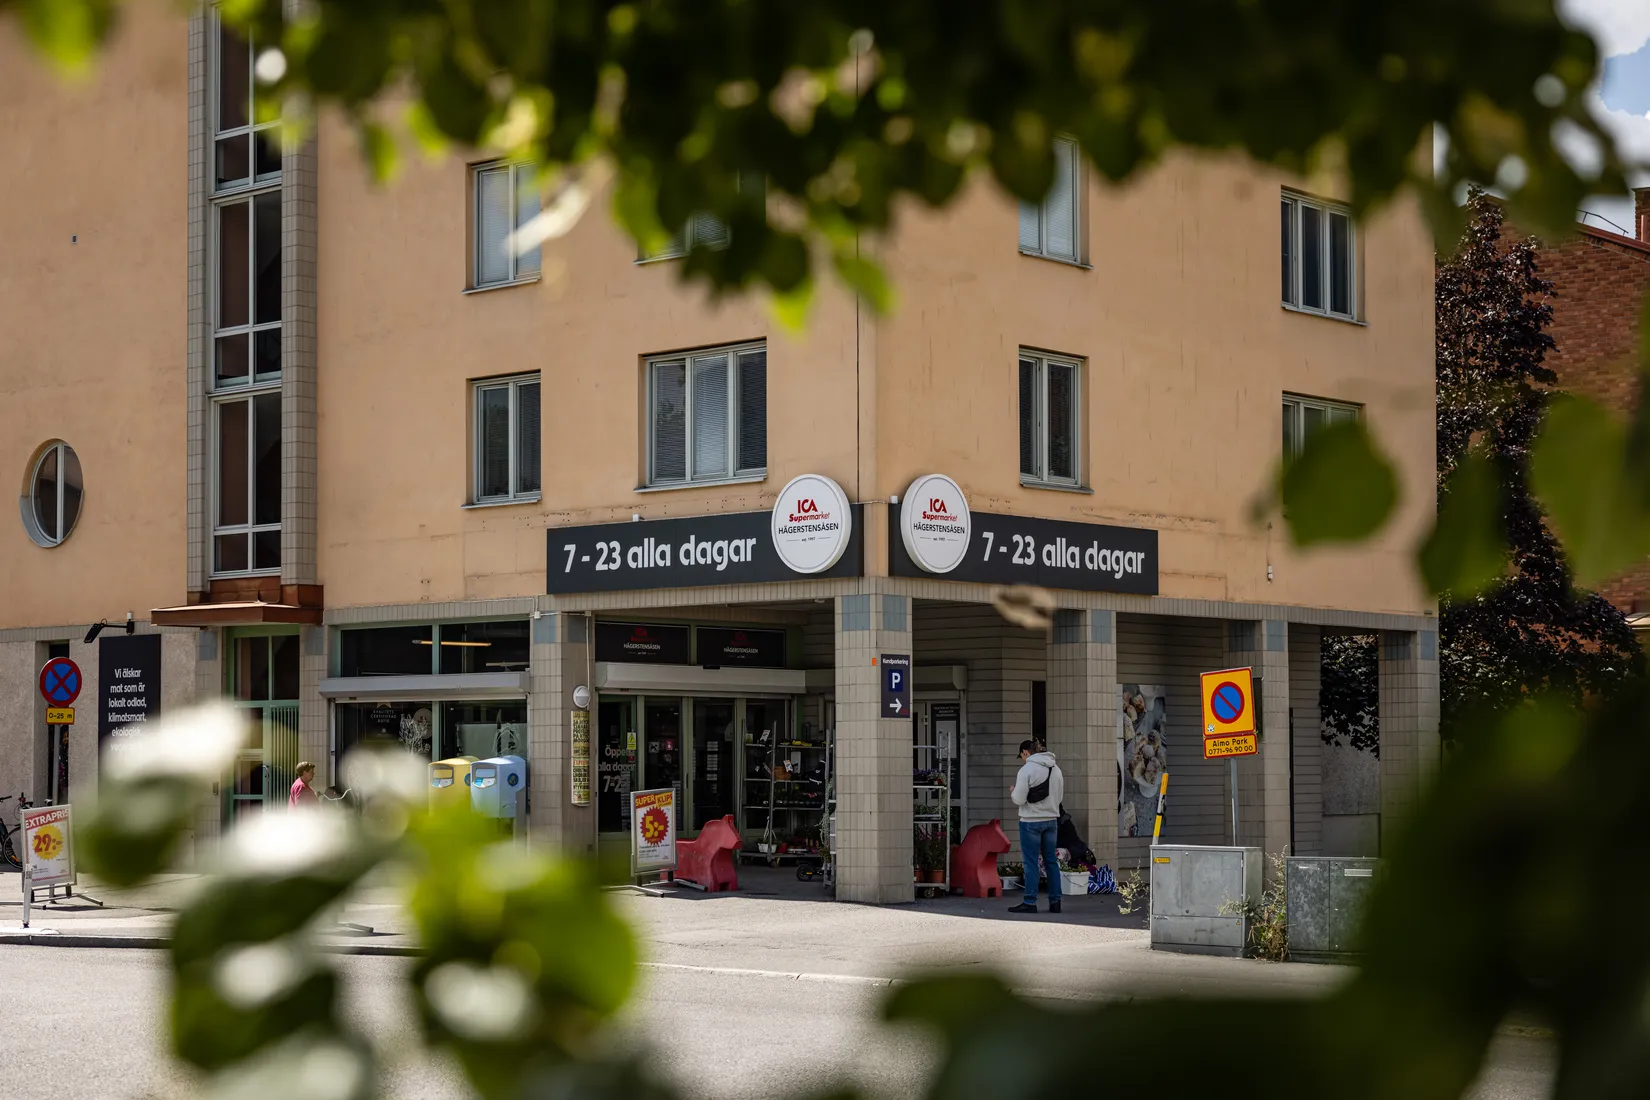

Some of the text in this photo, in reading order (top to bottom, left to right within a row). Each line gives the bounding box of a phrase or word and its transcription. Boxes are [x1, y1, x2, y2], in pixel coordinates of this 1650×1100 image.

[797, 499, 818, 513] ICA
[929, 498, 947, 513] ICA
[788, 511, 831, 523] Supermarket
[922, 511, 958, 522] Supermarket
[778, 522, 839, 534] HÄGERSTENSÅSEN
[913, 522, 965, 534] HÄGERSTENSÅSEN
[563, 544, 576, 573] 7
[595, 541, 622, 571] 23
[627, 537, 671, 568] alla
[679, 535, 757, 571] dagar
[982, 531, 994, 562] 7
[1012, 534, 1036, 565] 23
[1042, 537, 1080, 569] alla
[1084, 540, 1145, 580] dagar
[114, 668, 142, 678] Vi älskar
[891, 672, 901, 689] P
[110, 682, 145, 693] mat som är
[108, 697, 147, 708] lokalt odlad,
[108, 712, 147, 722] klimatsmart,
[635, 795, 655, 806] SUPER
[25, 808, 69, 829] EXTRAPRIS
